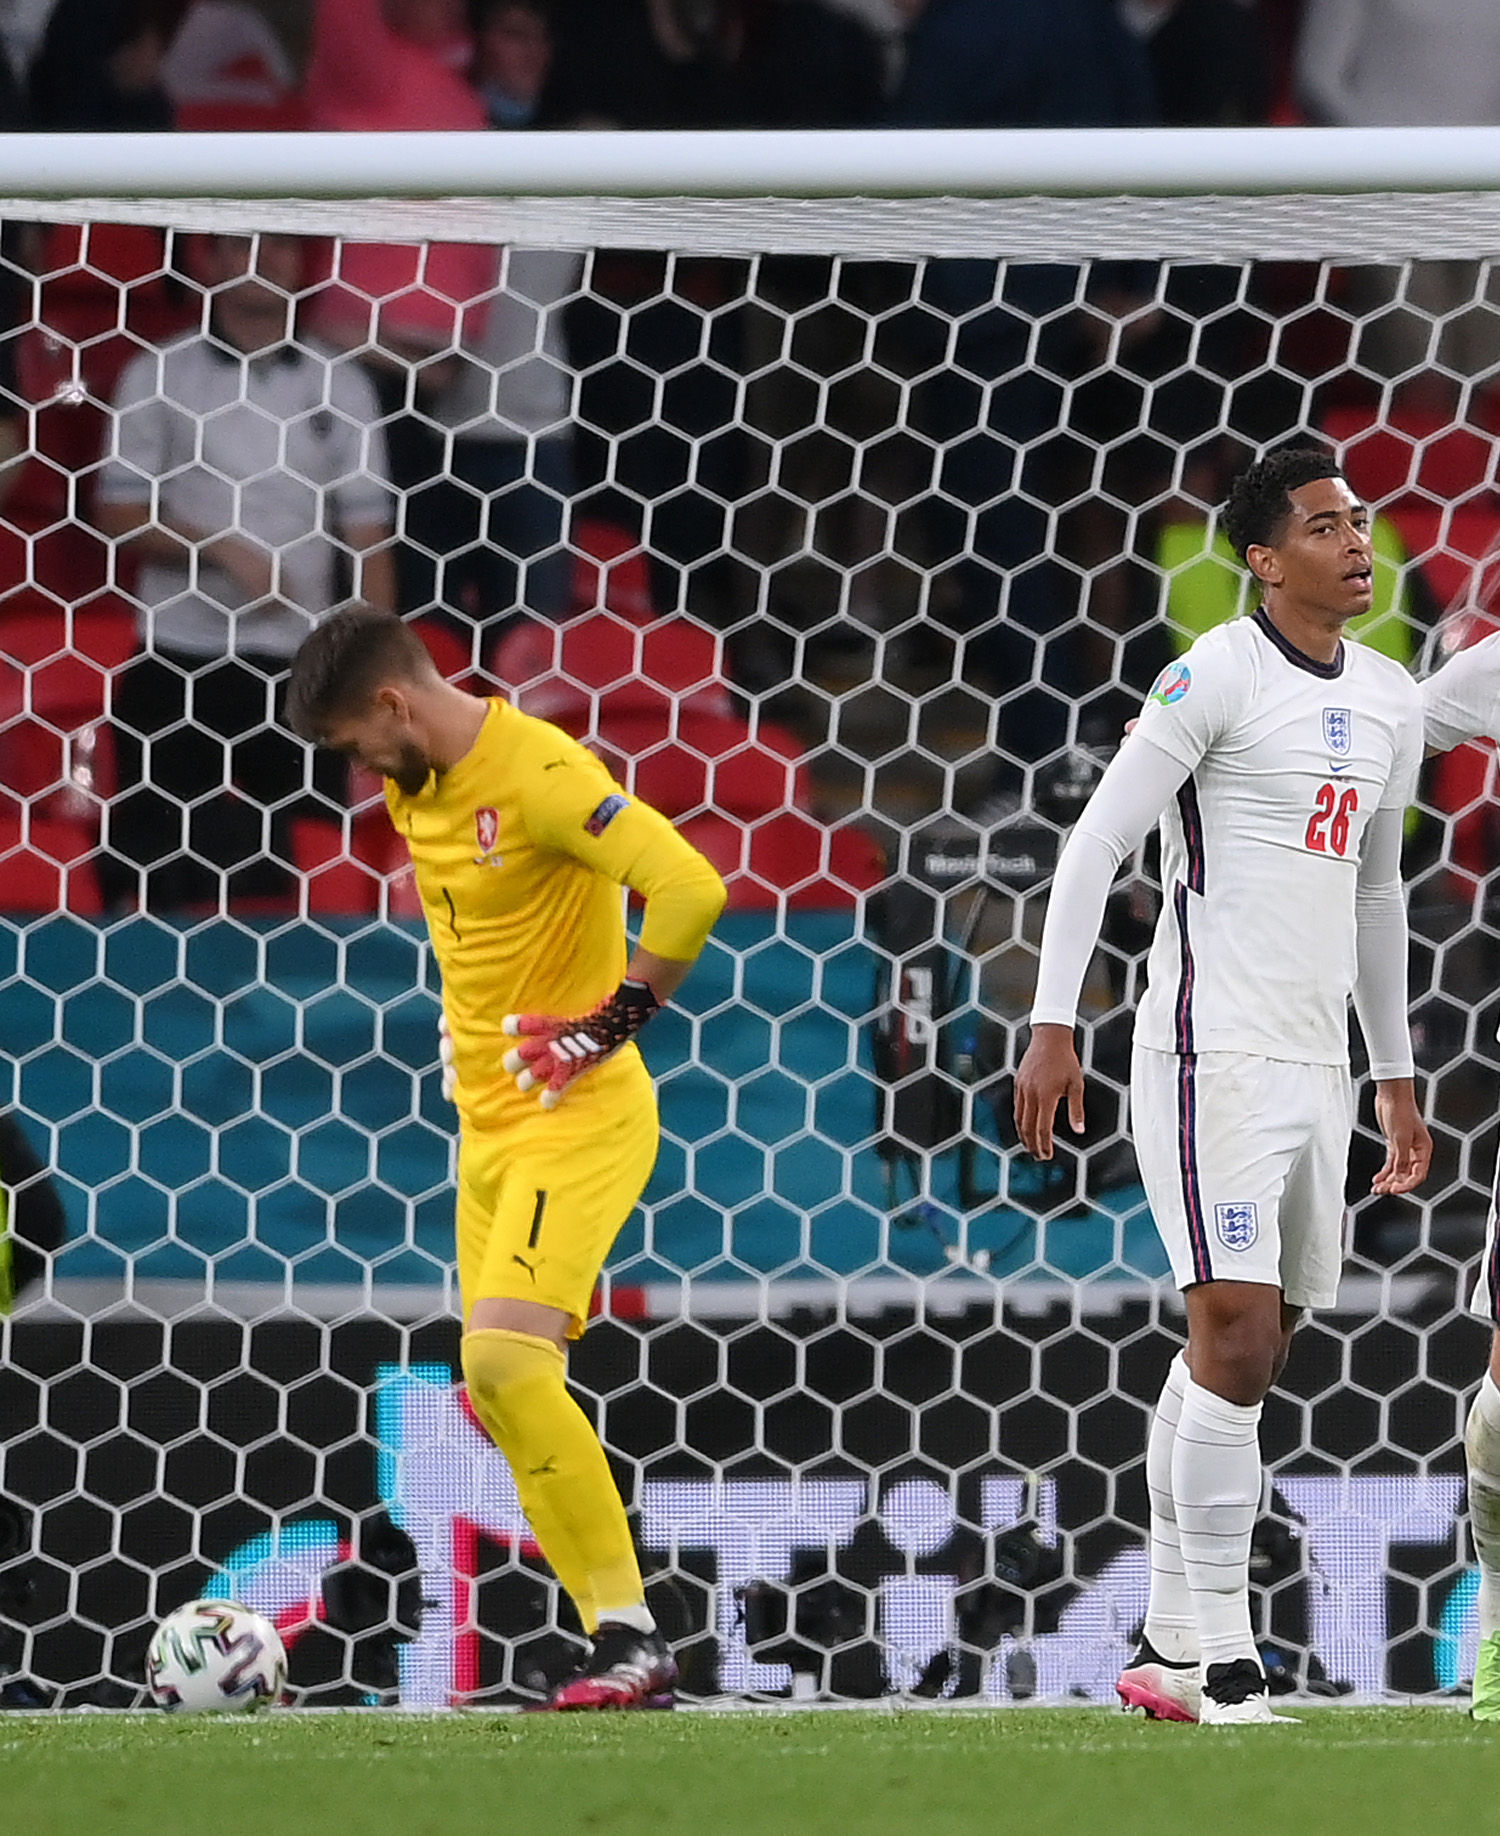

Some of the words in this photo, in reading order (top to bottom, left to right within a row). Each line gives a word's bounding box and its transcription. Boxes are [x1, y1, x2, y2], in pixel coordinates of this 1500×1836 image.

[1304, 782, 1358, 857] 26
[442, 887, 462, 942] 1
[527, 1189, 547, 1249] 1
